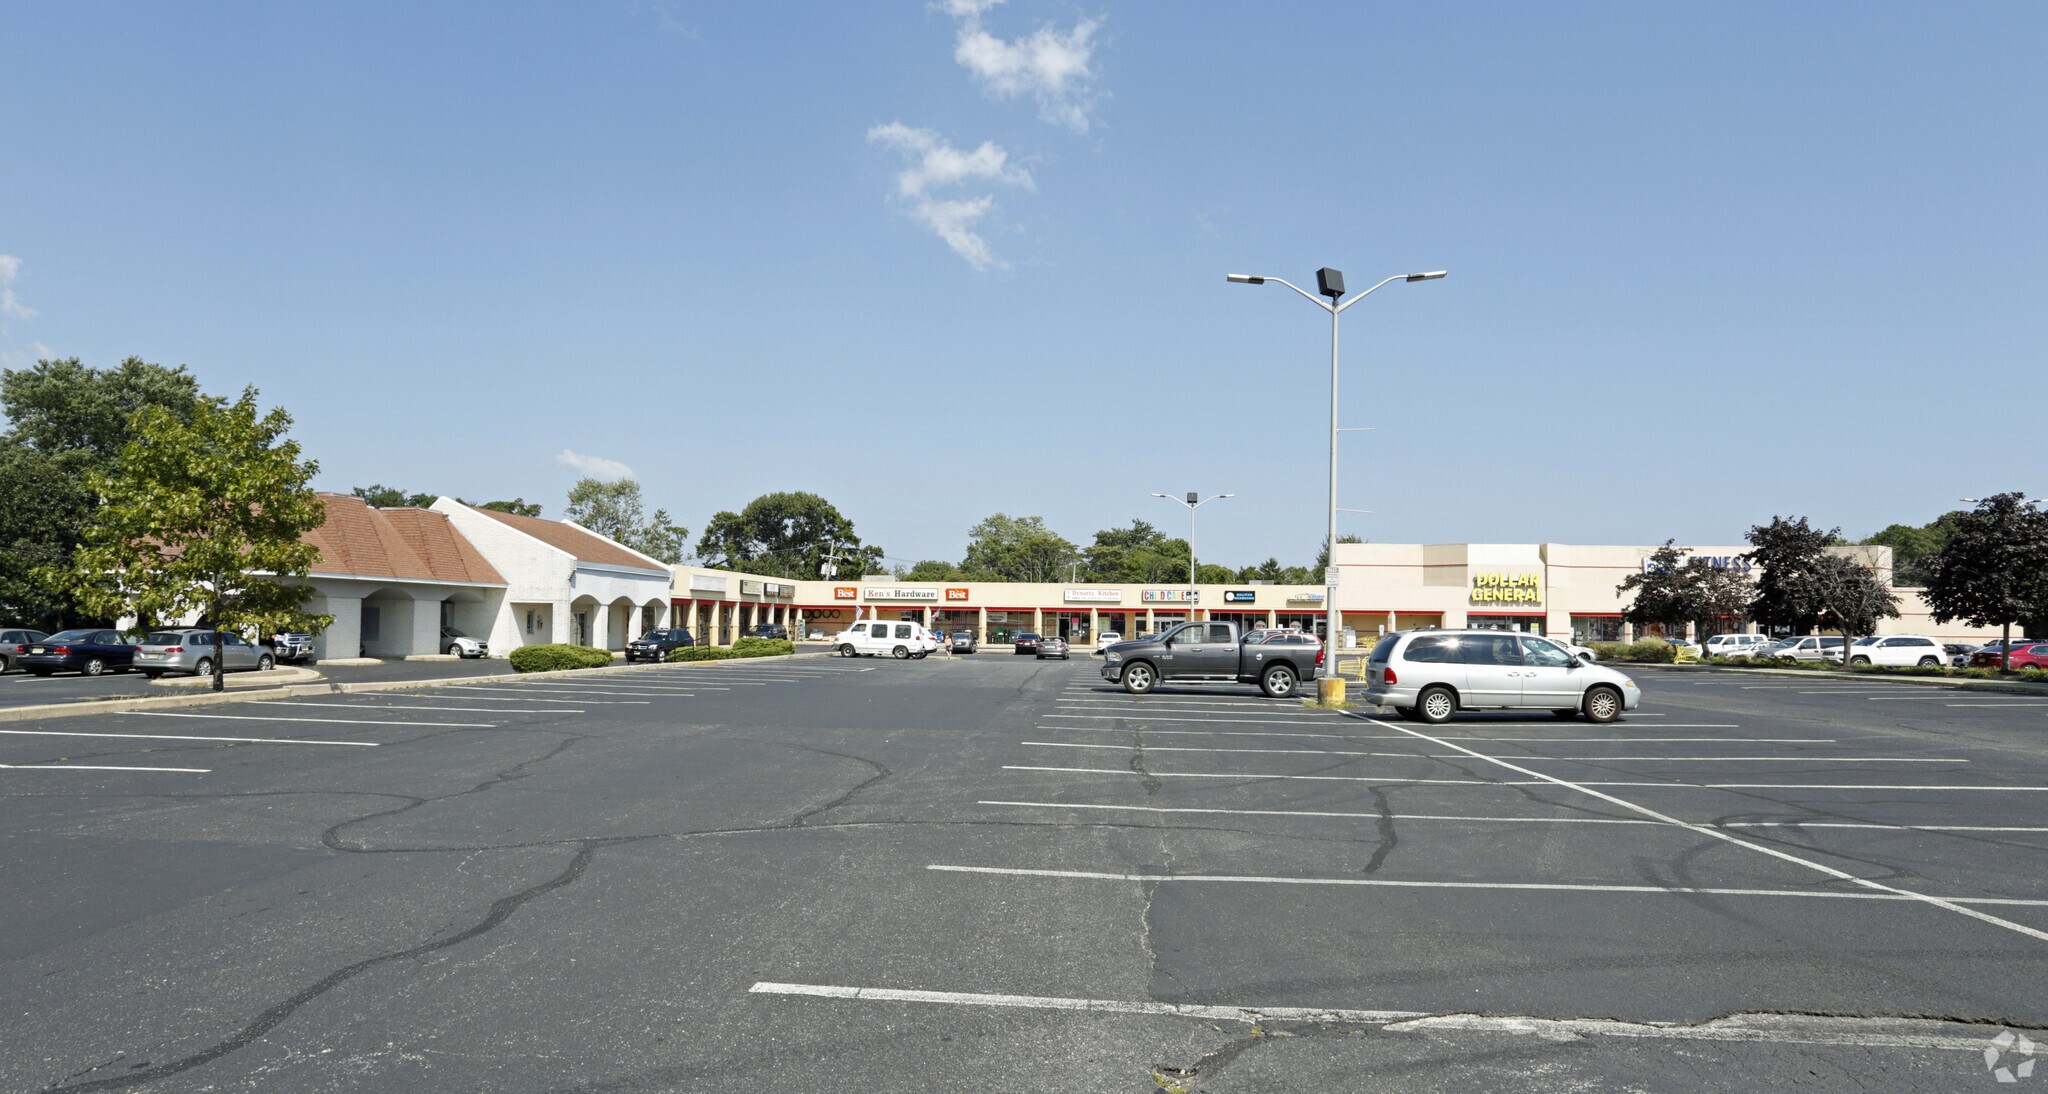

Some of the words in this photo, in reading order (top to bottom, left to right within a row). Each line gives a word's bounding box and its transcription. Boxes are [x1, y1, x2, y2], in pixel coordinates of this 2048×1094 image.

[1476, 571, 1540, 587] DOLLAR
[837, 589, 855, 598] Best
[868, 589, 891, 597] Ken's
[894, 589, 935, 598] Hardware
[949, 590, 967, 599] Best
[1166, 591, 1186, 601] CARE
[1471, 587, 1542, 603] GENERAL
